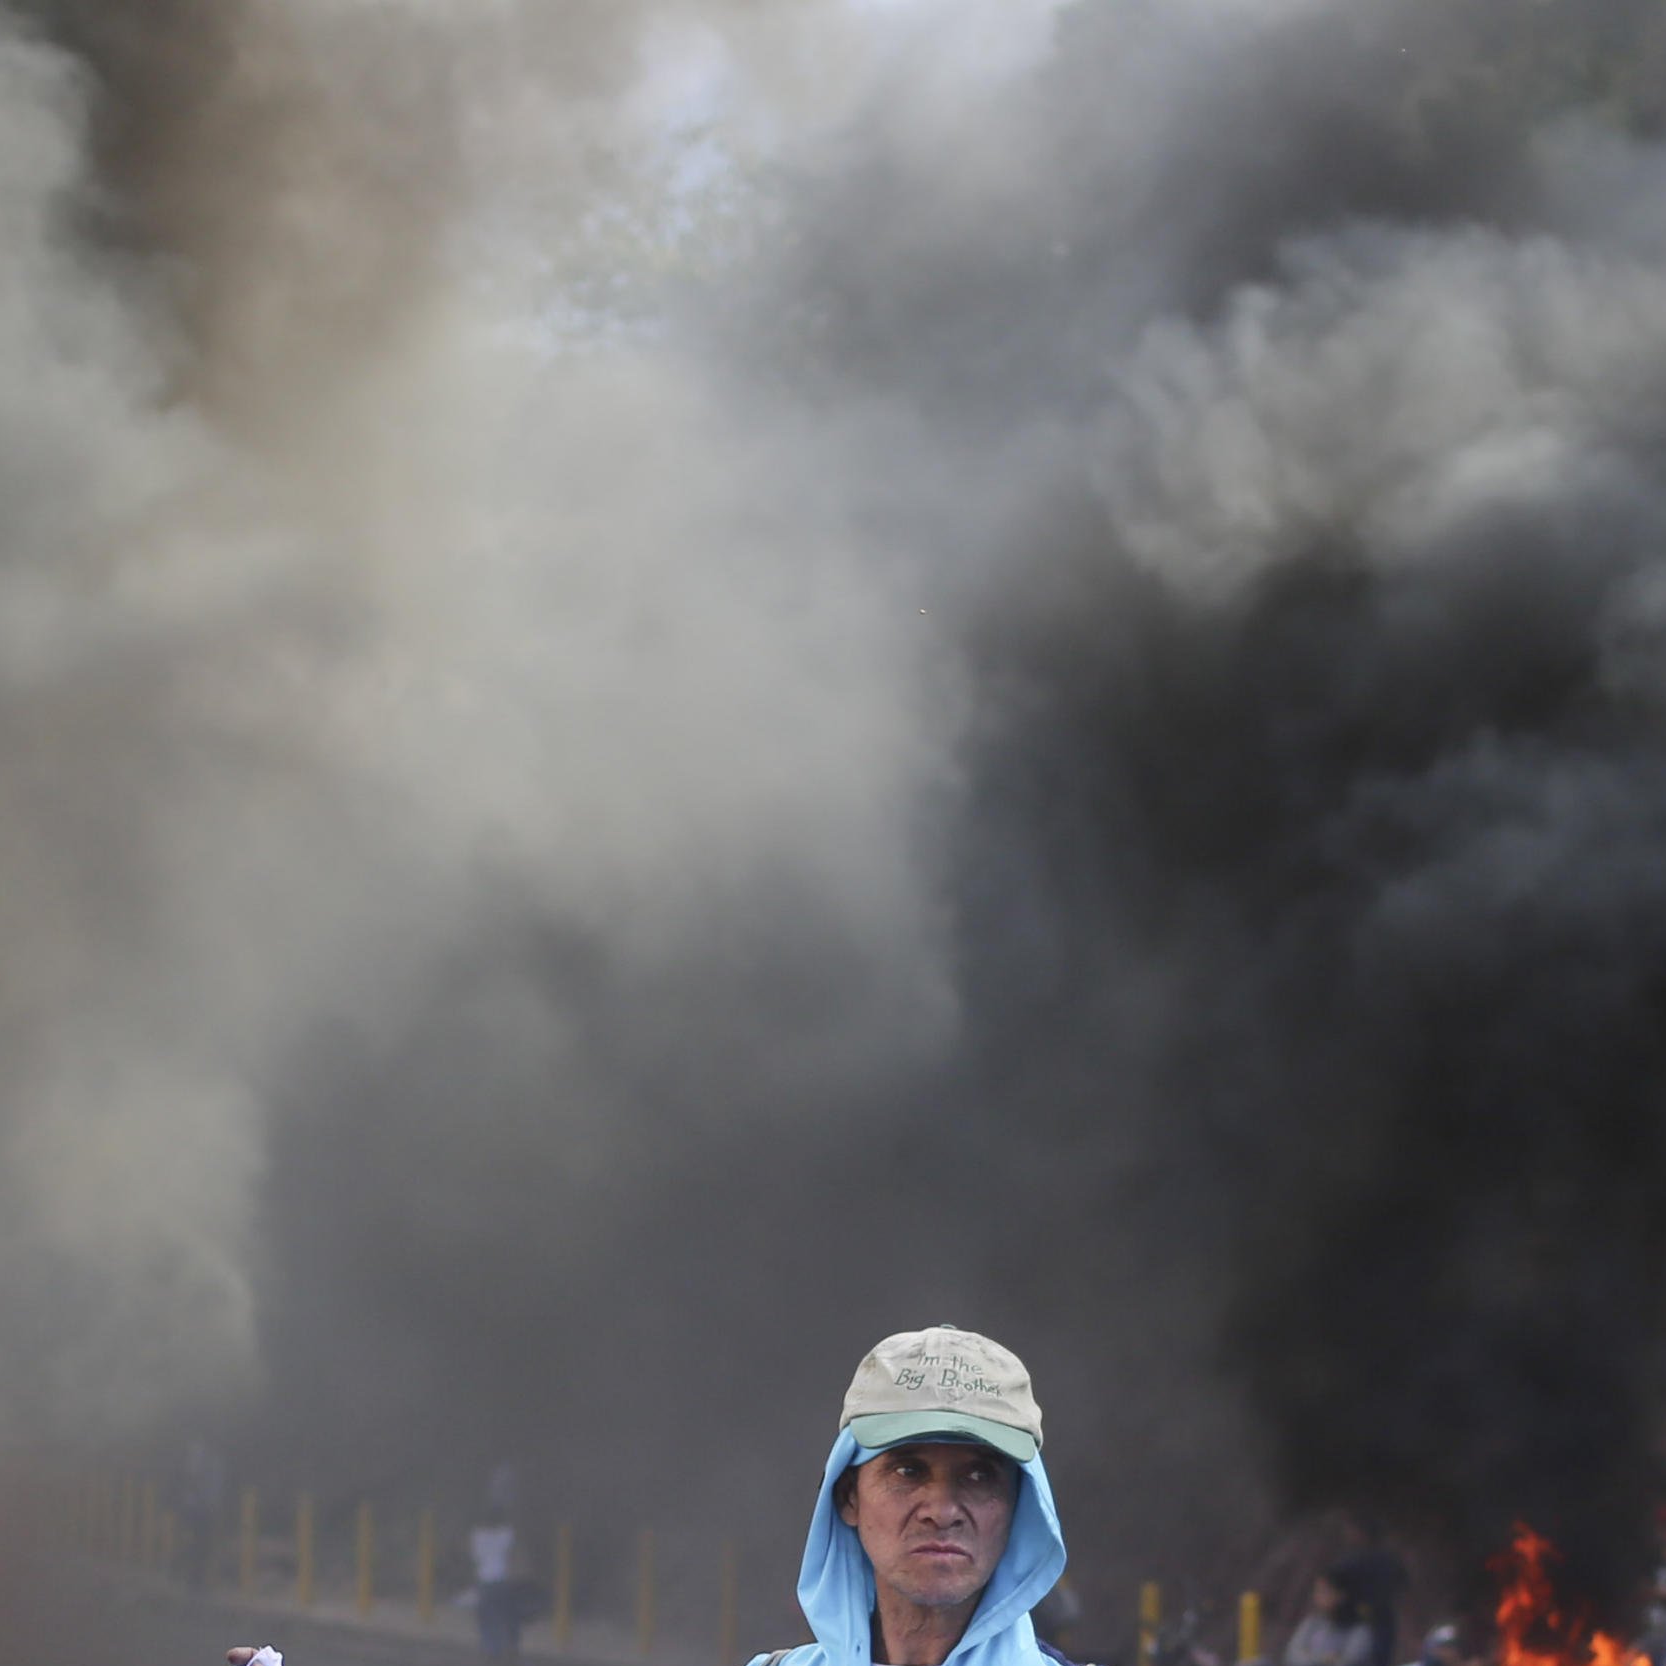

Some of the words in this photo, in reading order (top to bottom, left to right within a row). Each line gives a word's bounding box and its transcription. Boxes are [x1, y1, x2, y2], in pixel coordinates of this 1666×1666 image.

[951, 1356, 984, 1375] the
[894, 1368, 925, 1390] Big
[937, 1368, 1002, 1397] Brother
